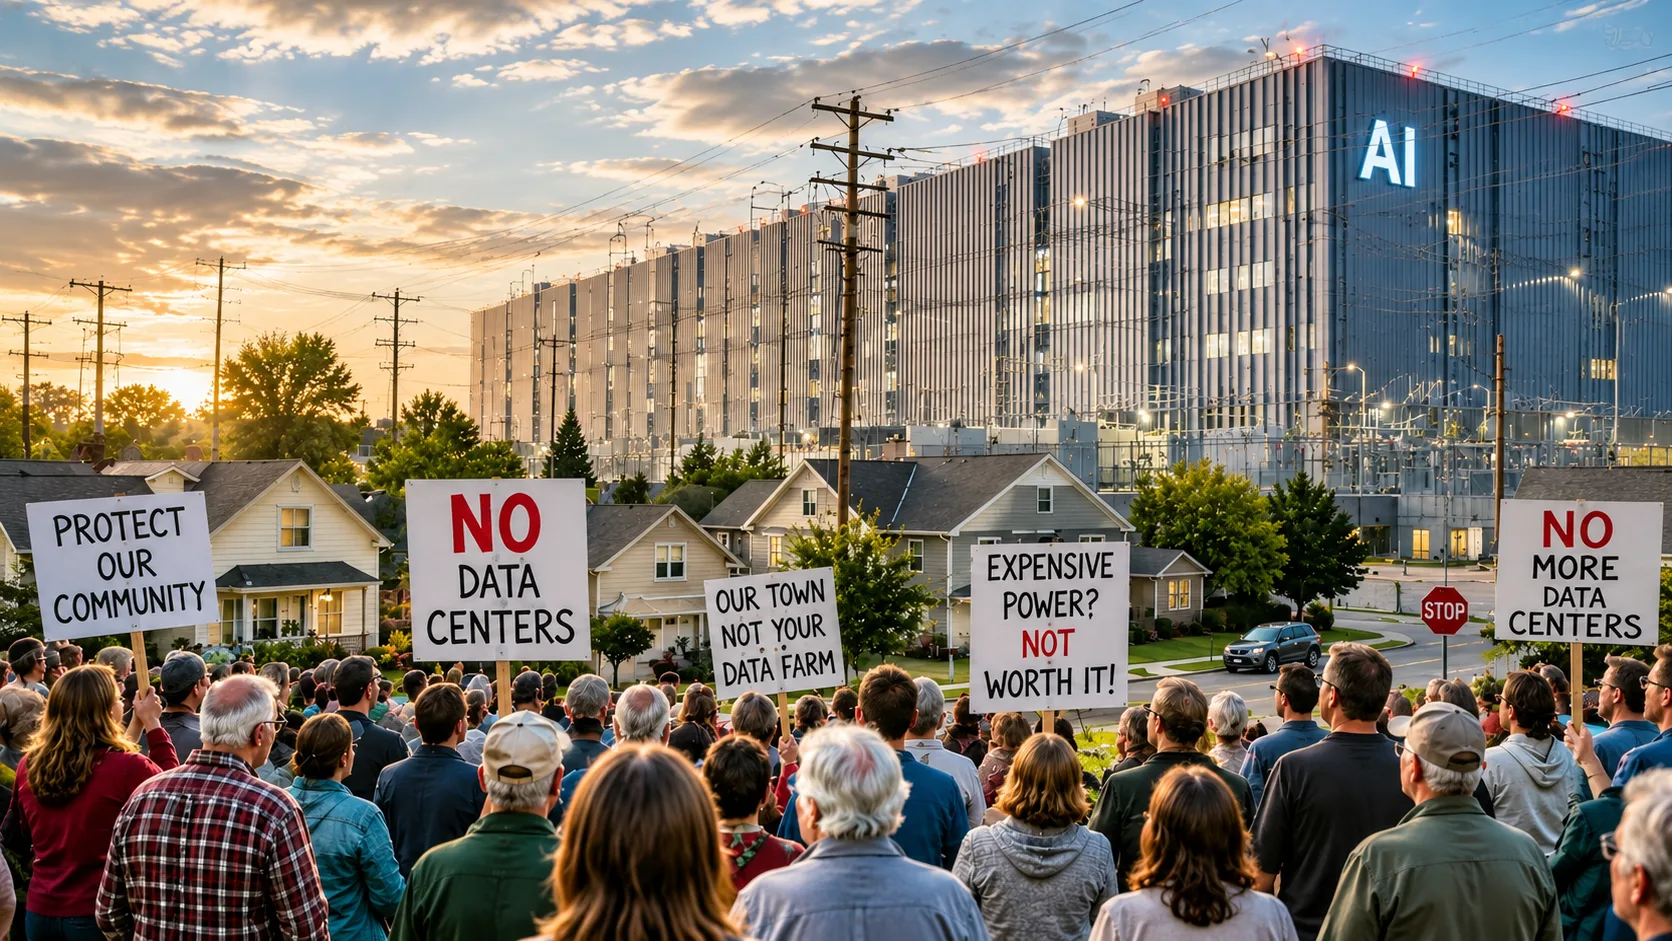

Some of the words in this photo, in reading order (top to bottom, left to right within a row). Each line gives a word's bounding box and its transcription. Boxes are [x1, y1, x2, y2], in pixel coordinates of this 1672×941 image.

[1359, 119, 1416, 187] AI
[52, 505, 186, 548] PROTECT
[450, 491, 542, 554] NO
[1542, 510, 1614, 549] NO
[97, 548, 158, 581] OUR
[458, 563, 541, 599] DATA
[987, 551, 1115, 582] EXPENSIVE
[1532, 554, 1620, 581] MORE
[53, 579, 205, 621] COMMUNITY
[715, 585, 761, 614] OUR
[765, 578, 826, 609] TOWN
[1003, 587, 1100, 621] POWER?
[1424, 601, 1465, 620] STOP
[1543, 585, 1607, 608] DATA
[426, 608, 576, 646] CENTERS
[720, 620, 763, 650] NOT
[770, 612, 827, 643] YOUR
[1021, 627, 1076, 659] NOT
[1508, 610, 1643, 640] CENTERS
[722, 656, 775, 687] DATA
[780, 649, 836, 680] FARM
[983, 666, 1073, 700] WORTH
[1084, 663, 1116, 695] IT!
